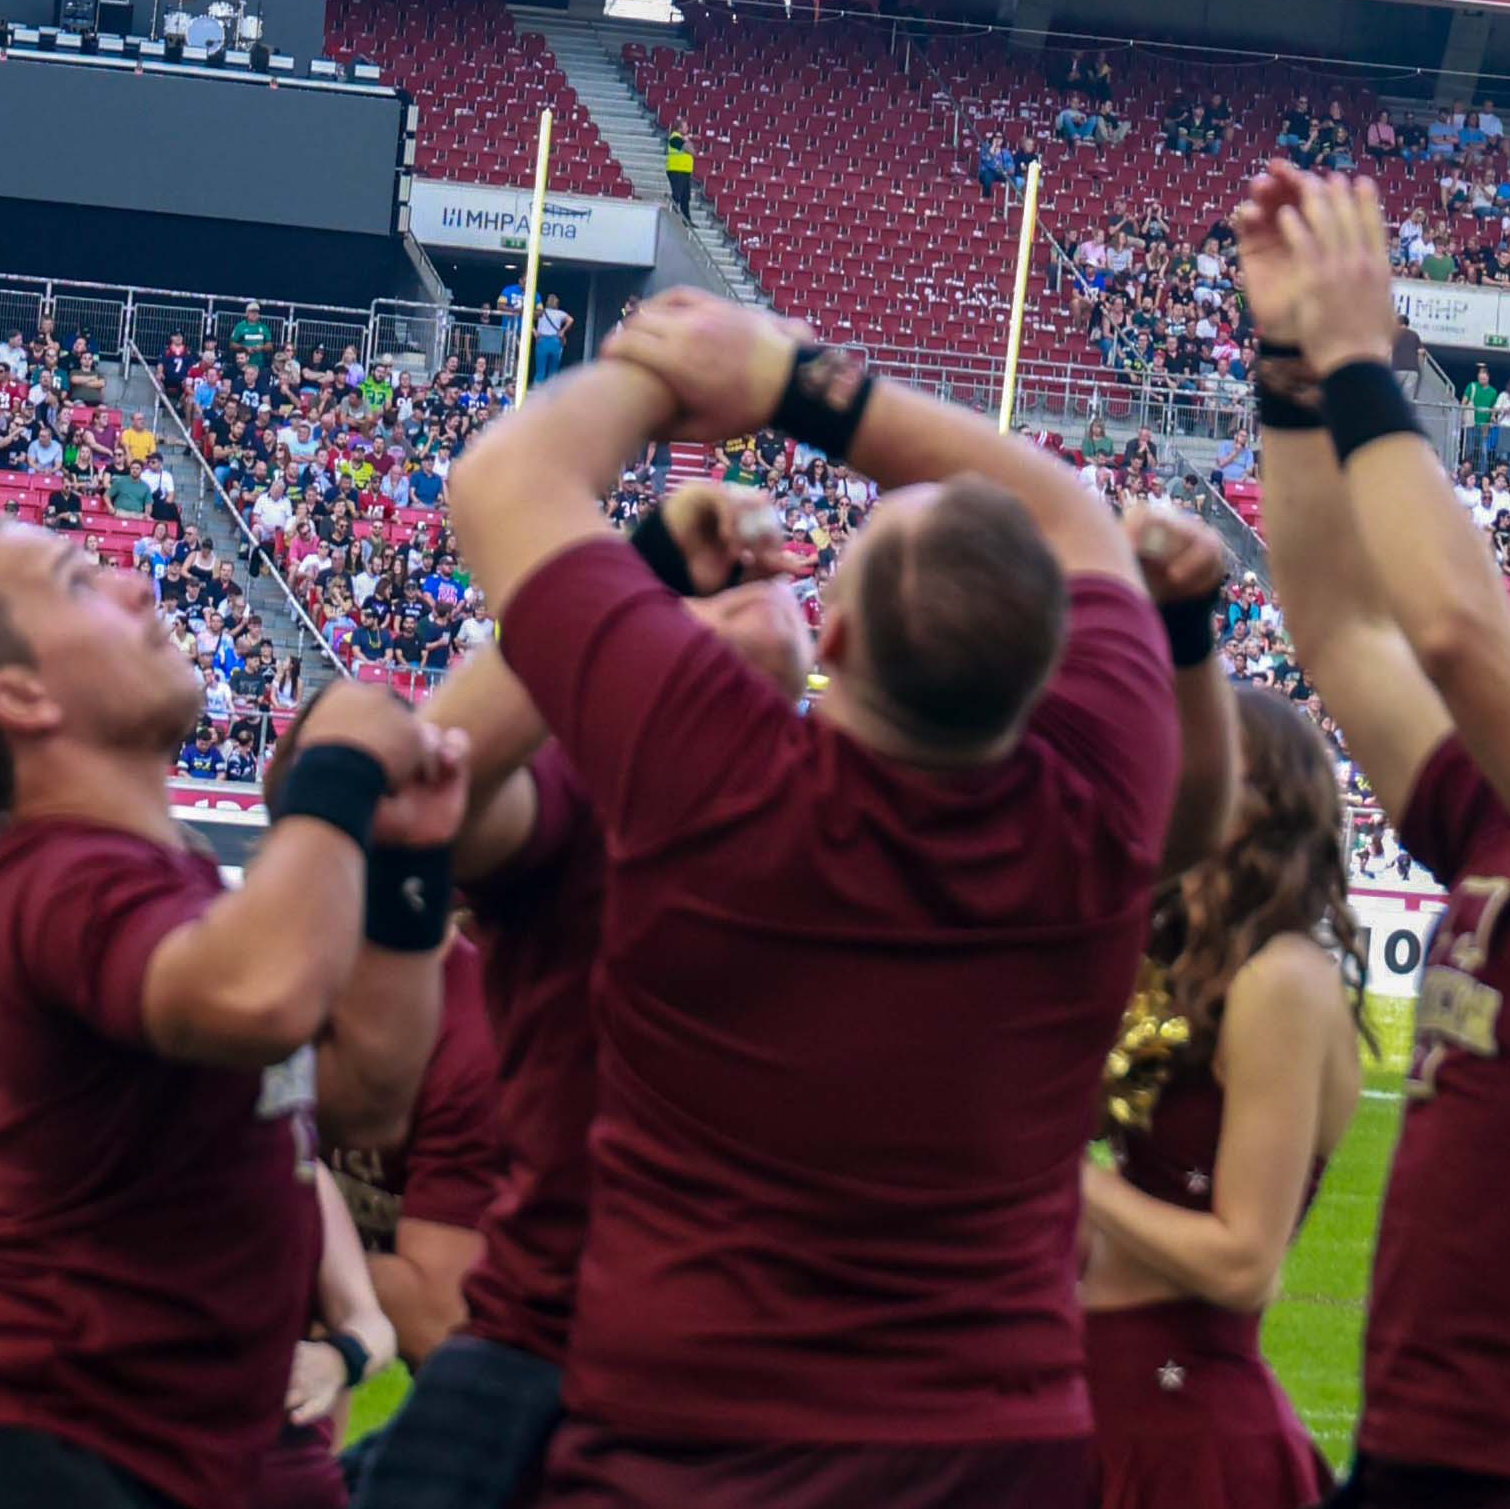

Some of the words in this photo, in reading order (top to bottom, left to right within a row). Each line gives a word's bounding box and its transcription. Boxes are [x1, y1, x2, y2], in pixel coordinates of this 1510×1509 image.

[466, 210, 514, 232] MHP
[516, 214, 576, 238] Aena
[1416, 299, 1468, 320] MHP
